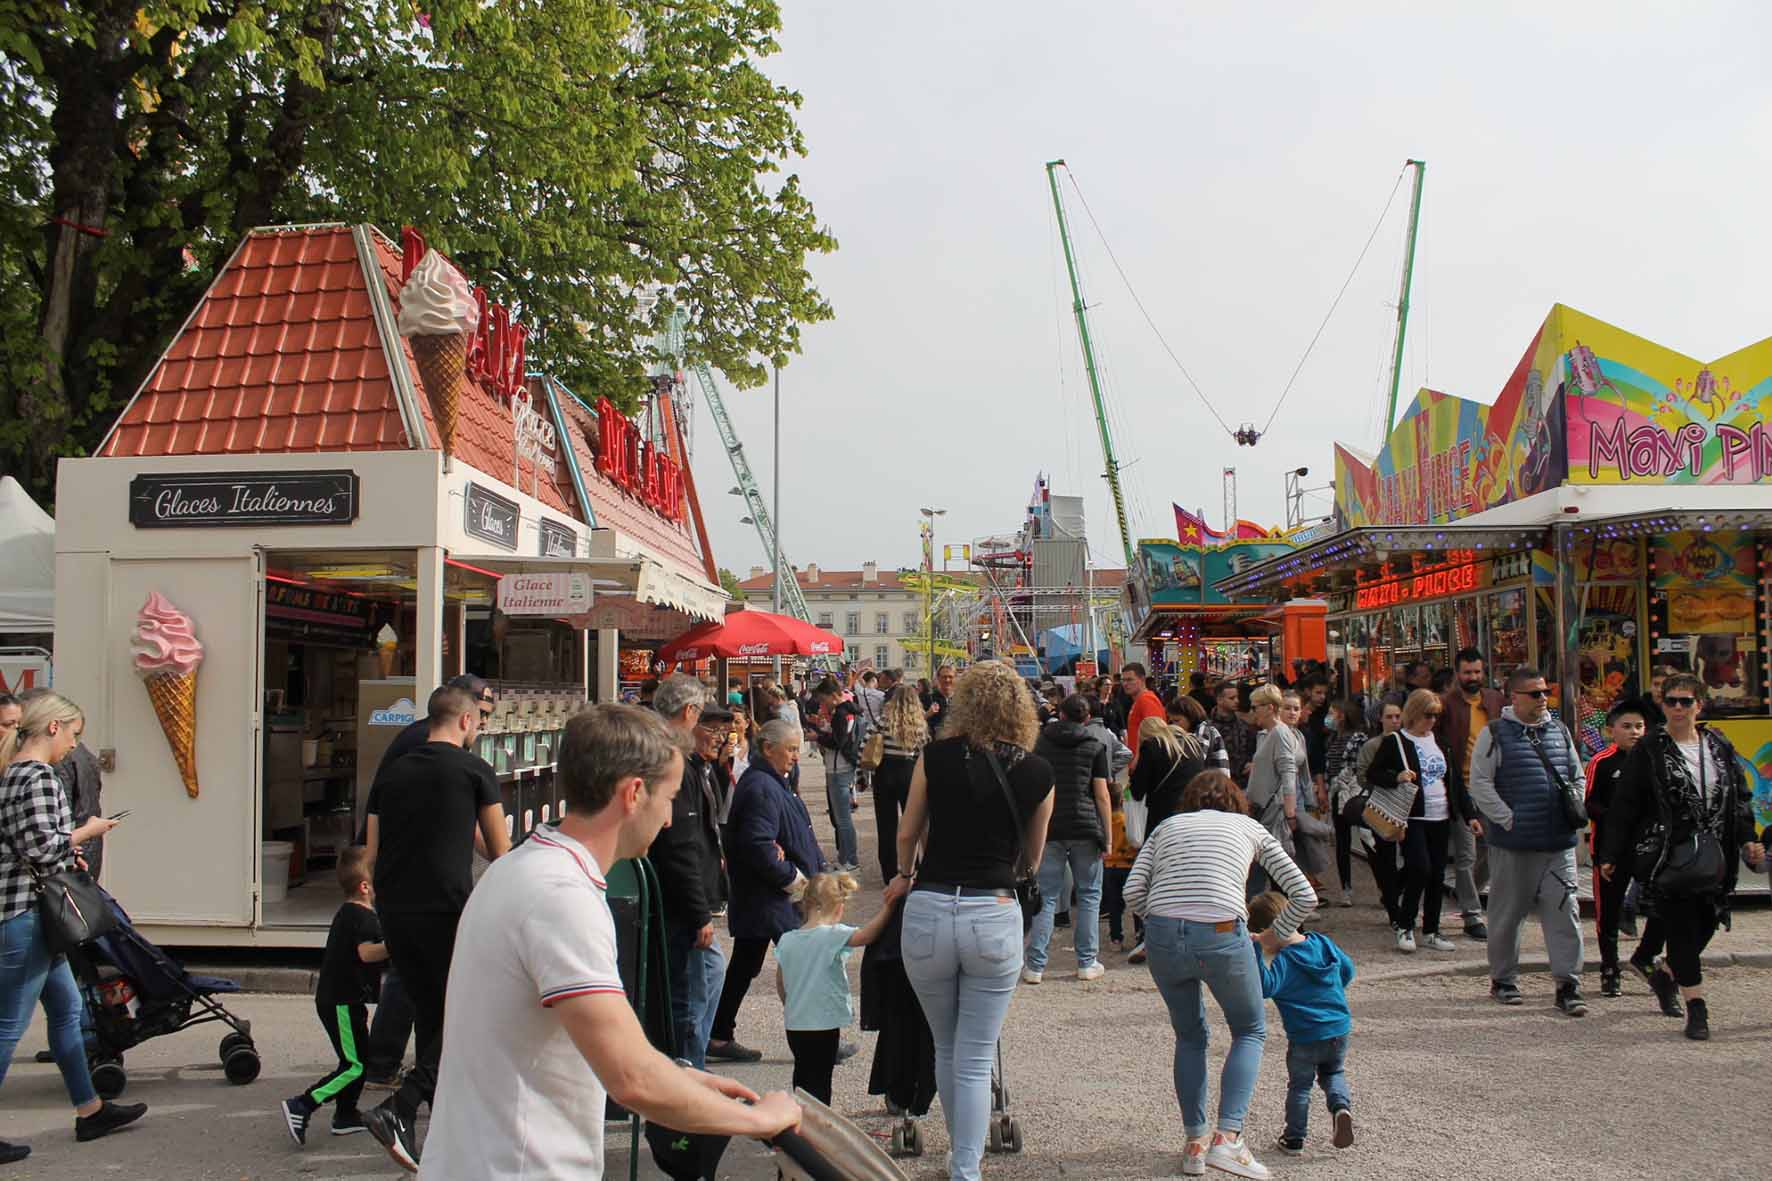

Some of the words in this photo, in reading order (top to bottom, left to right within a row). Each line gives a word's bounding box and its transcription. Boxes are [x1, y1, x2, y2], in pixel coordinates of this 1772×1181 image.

[1589, 416, 1708, 481] Maxi
[154, 488, 221, 519] Glaces
[227, 484, 337, 514] Italiennes
[481, 502, 504, 536] Glaces
[513, 578, 553, 591] Glace
[1357, 581, 1399, 608] MAXI
[1412, 563, 1473, 598] PINCE
[503, 595, 564, 609] Italienne
